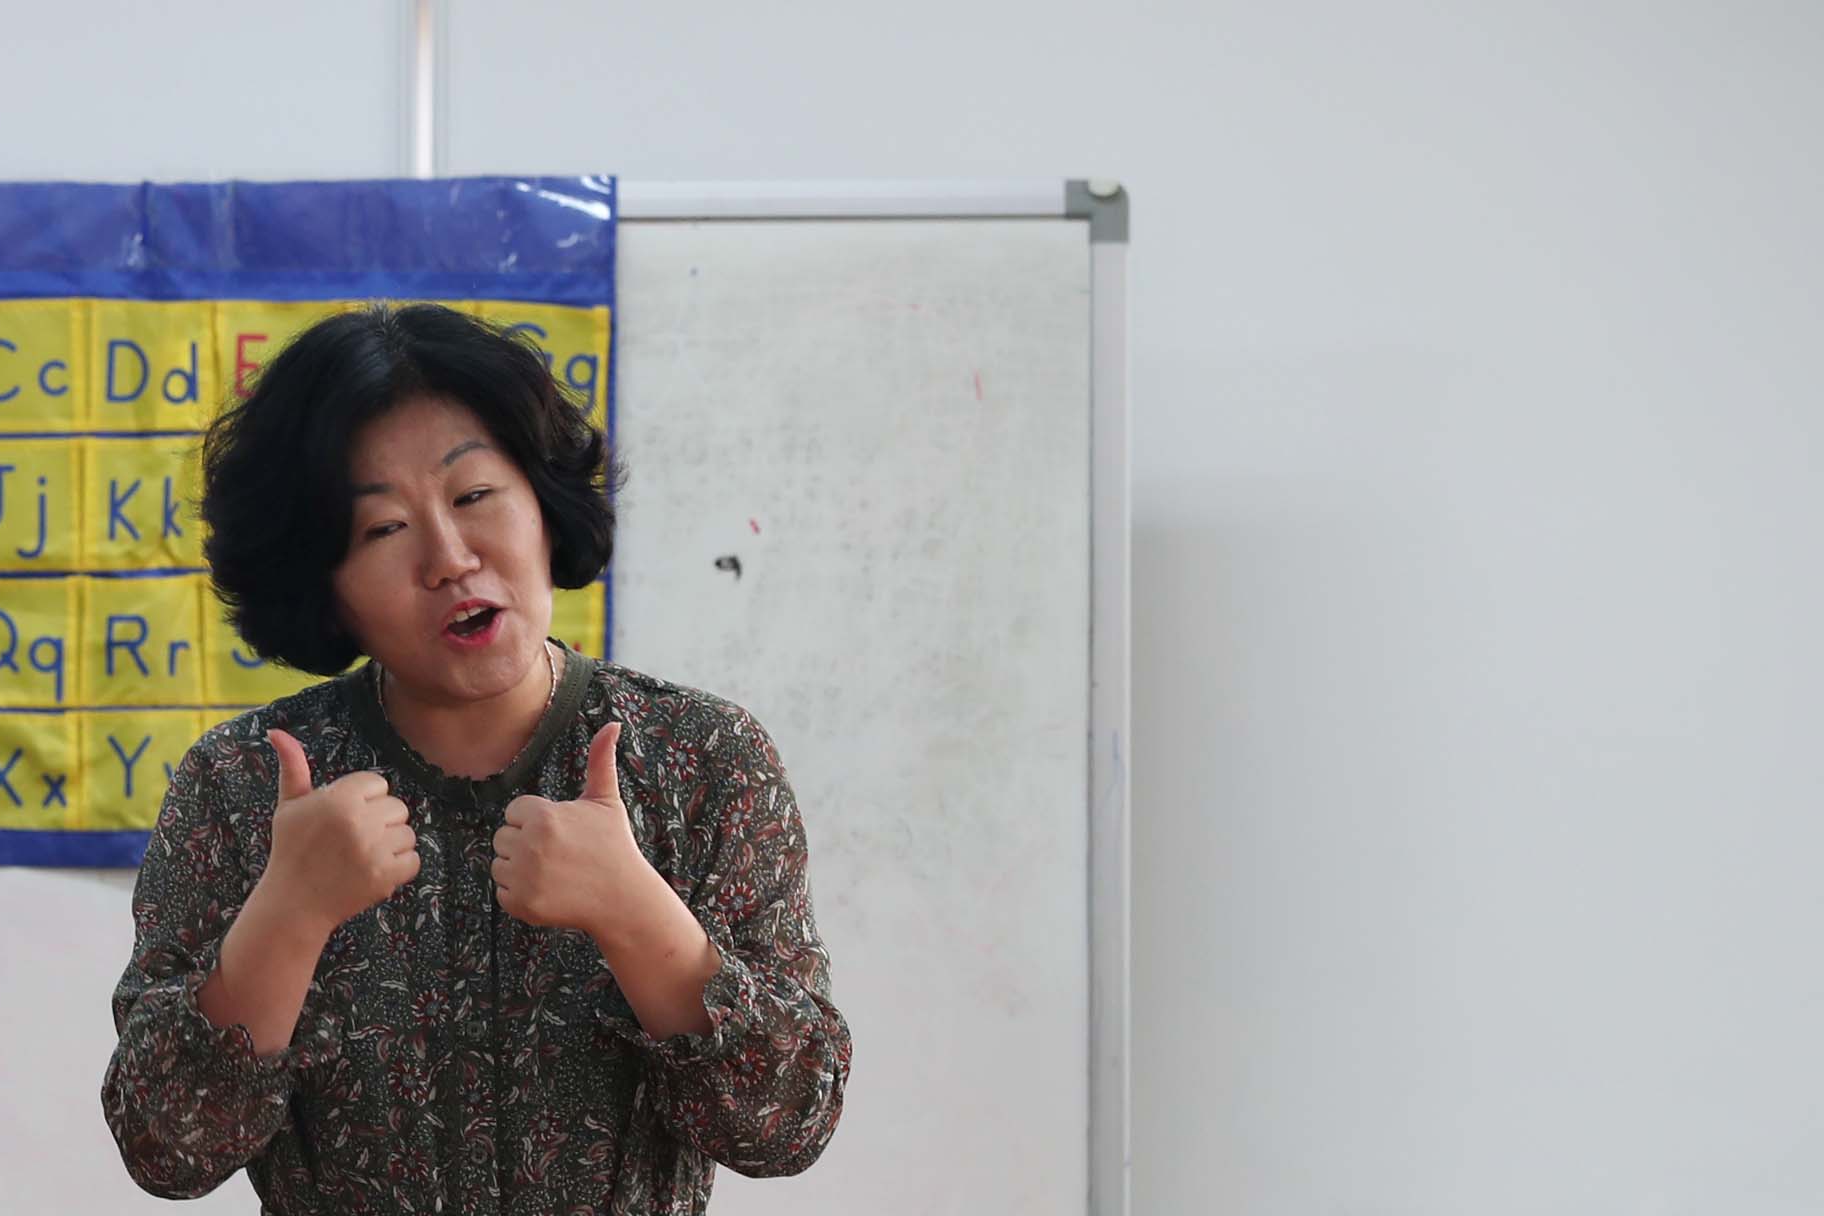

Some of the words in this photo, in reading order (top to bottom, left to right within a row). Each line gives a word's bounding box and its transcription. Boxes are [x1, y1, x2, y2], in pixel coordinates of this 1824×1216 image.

[106, 338, 199, 404] Dd
[107, 476, 183, 541] Kk
[105, 614, 190, 676] Rr
